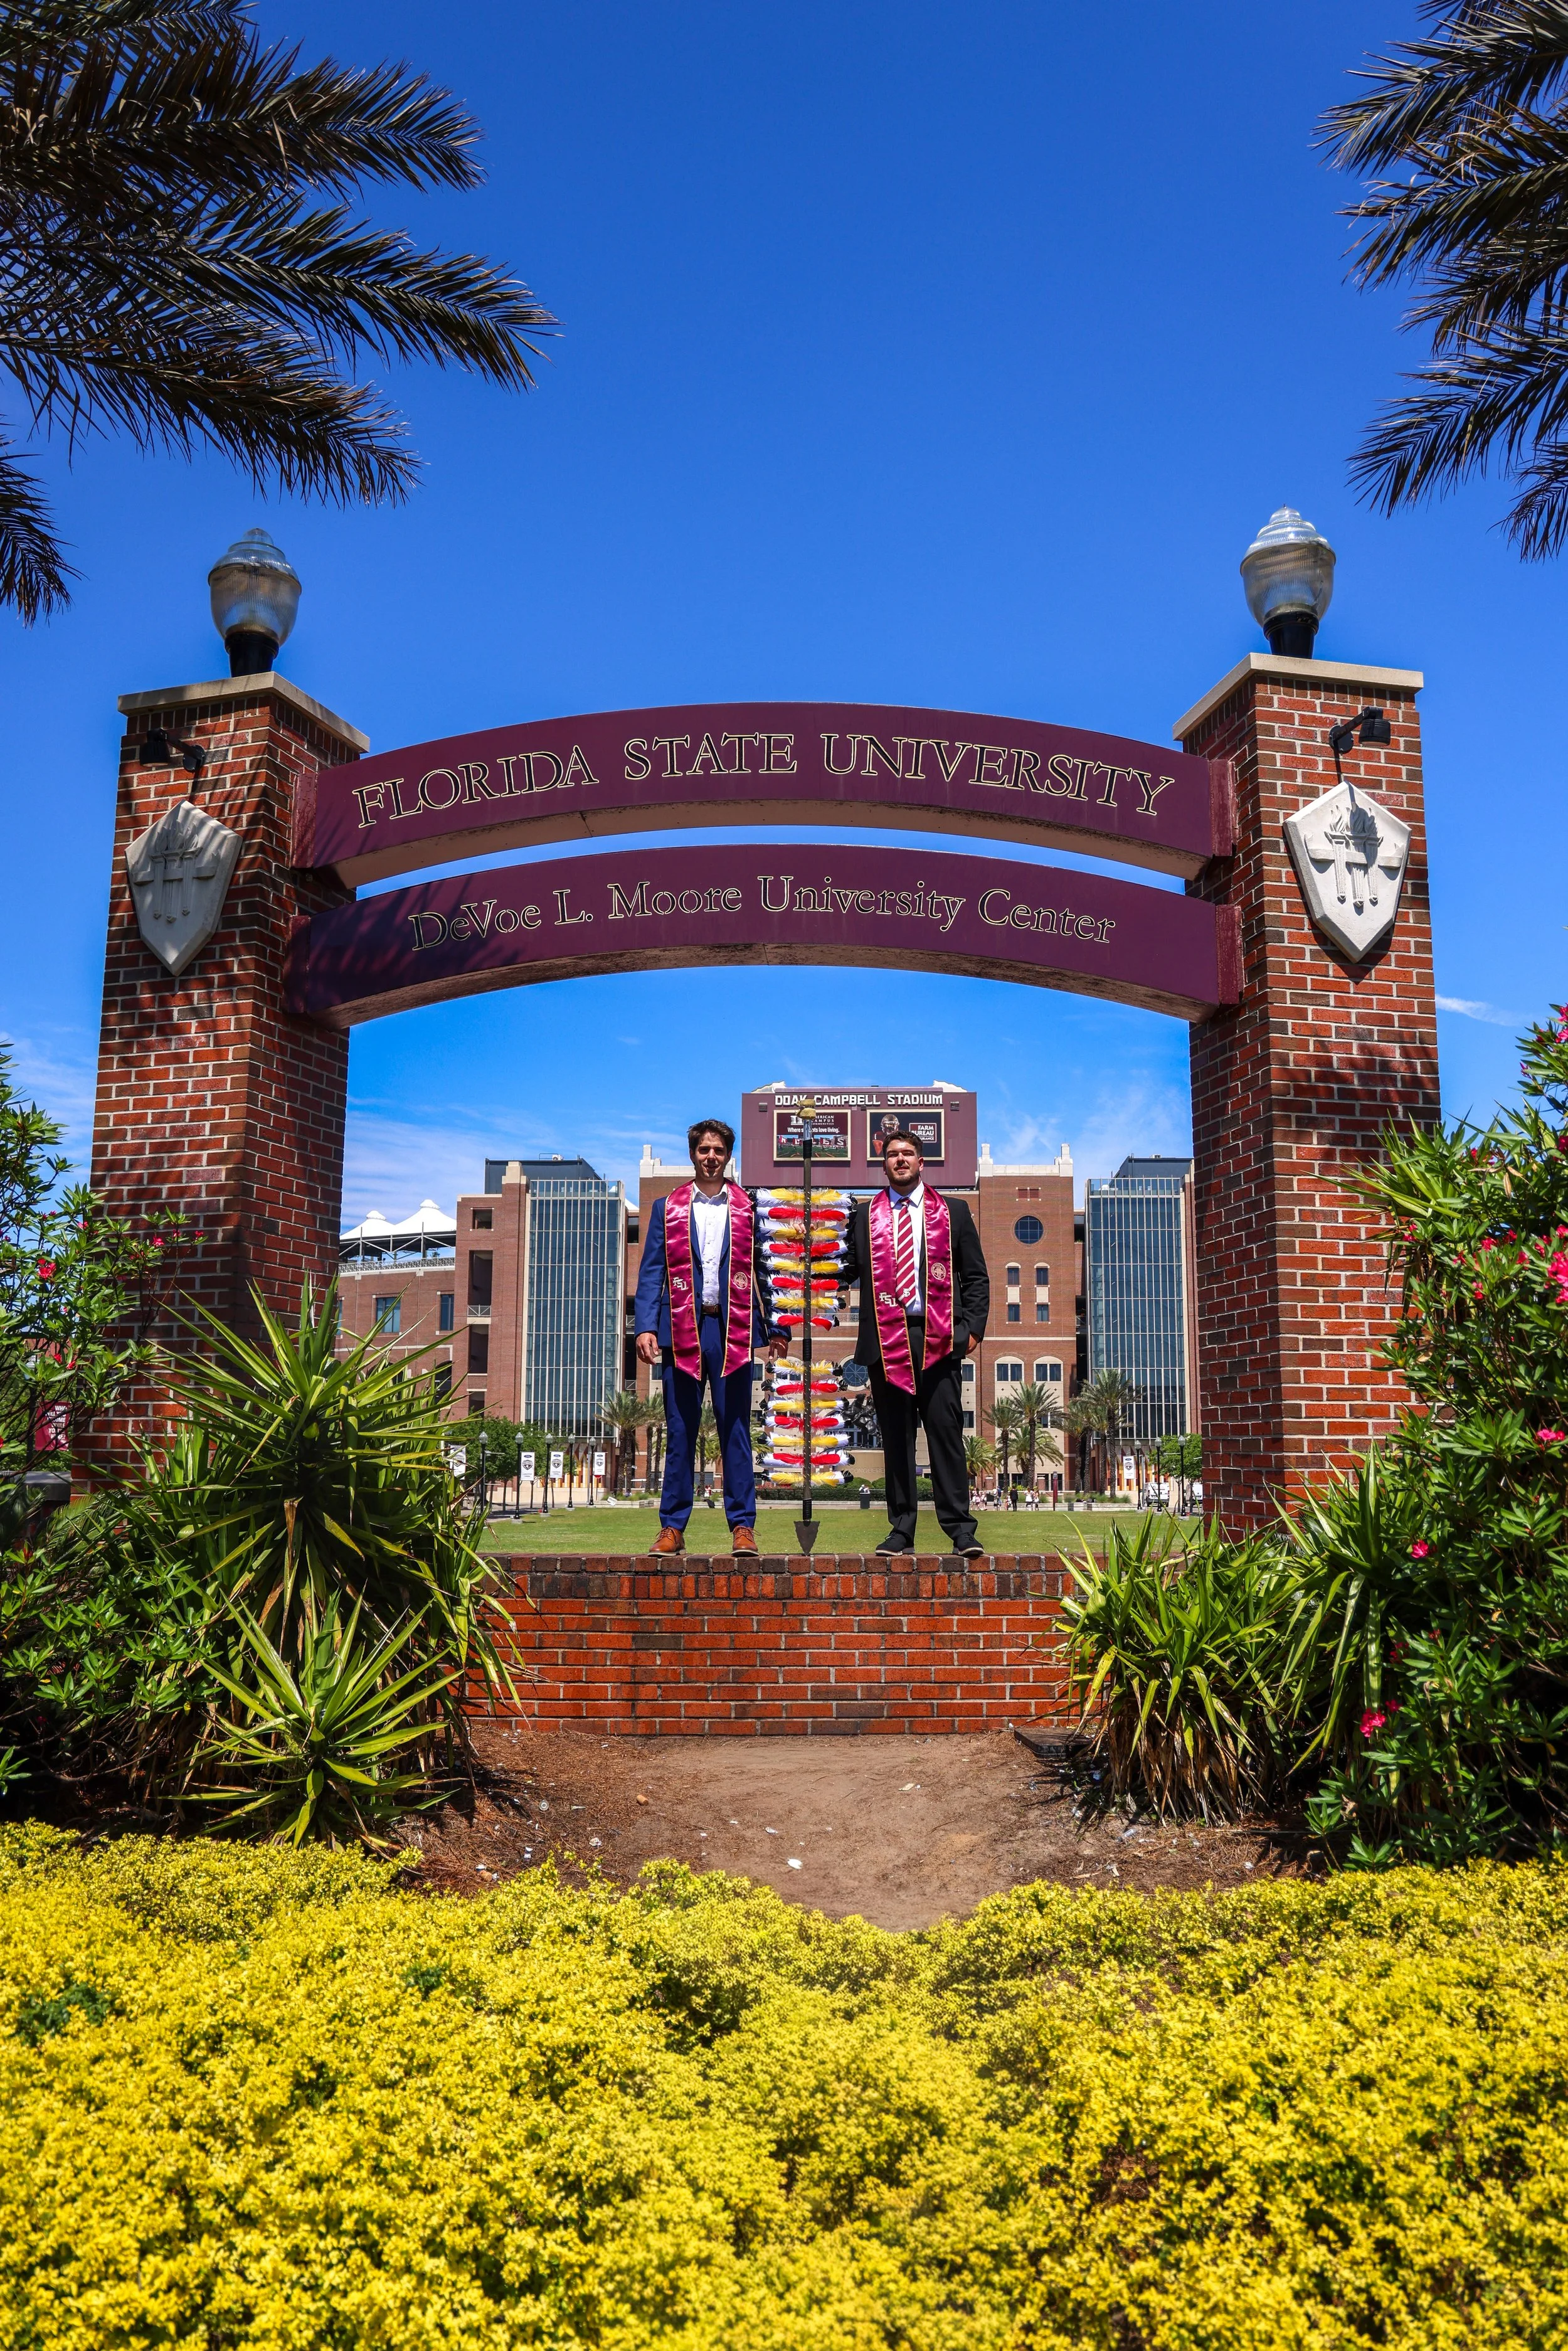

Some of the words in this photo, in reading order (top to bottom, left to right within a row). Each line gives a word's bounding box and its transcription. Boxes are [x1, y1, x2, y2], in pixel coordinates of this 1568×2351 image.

[352, 745, 599, 828] FLORIDA
[625, 732, 797, 780] STATE
[820, 733, 1175, 816] UNIVERSITY
[408, 900, 542, 951] DeVoe
[553, 889, 593, 926] L.
[607, 881, 741, 920] Moore
[757, 876, 965, 931] University
[978, 888, 1116, 943] Center
[815, 1095, 881, 1105] CAMPBELL
[887, 1094, 943, 1105] STADIUM
[672, 1276, 689, 1291] FSU
[879, 1292, 898, 1307] FSU
